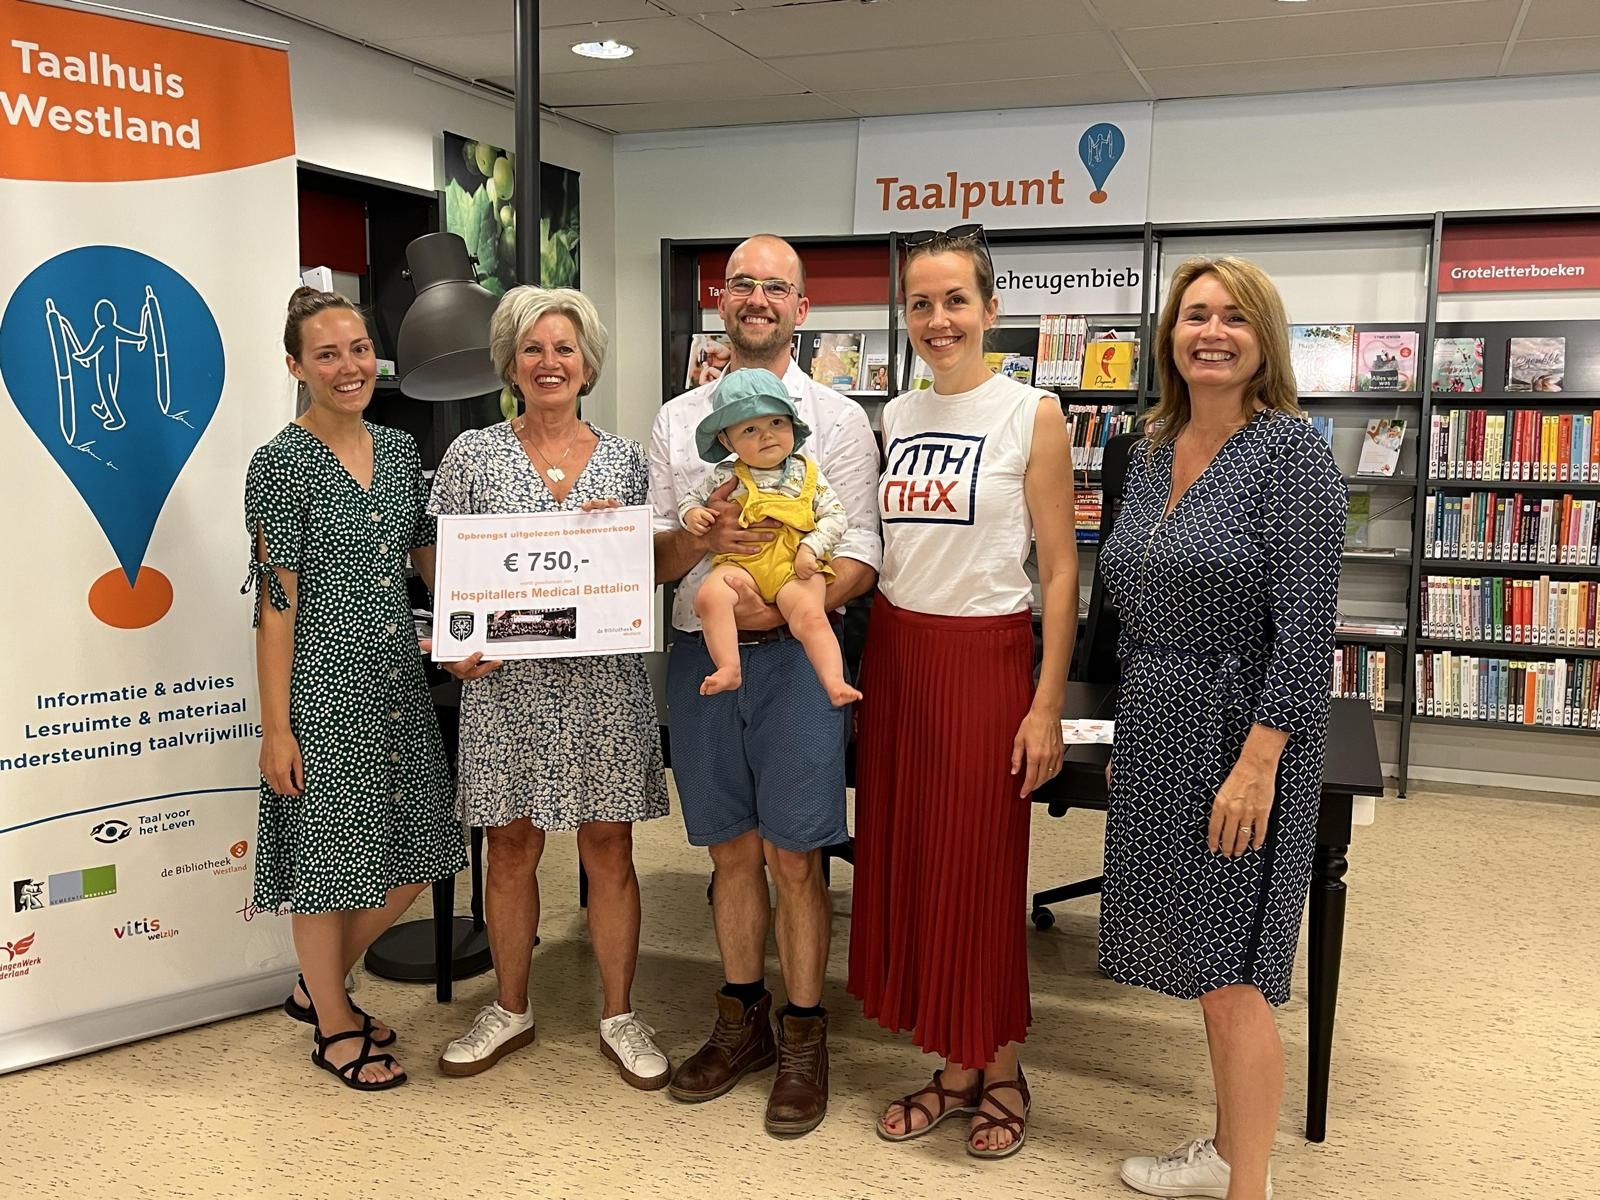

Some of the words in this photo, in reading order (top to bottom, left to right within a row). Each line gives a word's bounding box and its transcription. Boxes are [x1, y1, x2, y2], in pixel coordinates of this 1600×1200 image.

[11, 39, 185, 99] Taalhuis
[0, 91, 201, 150] Westland
[876, 170, 1065, 219] Taalpunt
[995, 268, 1139, 295] eheugenbieb
[1451, 264, 1585, 279] Groteletterboeken
[708, 286, 725, 297] Ta
[884, 480, 959, 512] ПНХ
[457, 531, 507, 541] Opbrengst
[511, 529, 560, 539] uitgelezen
[563, 524, 635, 537] boekenverkoop
[504, 553, 519, 572] €
[528, 551, 589, 573] 750,-
[451, 588, 528, 602] Hospitallers
[531, 587, 579, 598] Medical
[584, 583, 640, 595] Battalion
[37, 685, 148, 709] Informatie
[154, 682, 167, 696] &
[173, 676, 235, 693] advies
[25, 714, 131, 739] Lesruimte
[138, 711, 151, 725] &
[158, 698, 247, 723] materiaal
[0, 739, 142, 770] ndersteuning
[149, 722, 264, 751] taalvrijwillig
[138, 813, 162, 825] Taal
[165, 809, 191, 821] voor
[139, 824, 159, 835] het
[162, 818, 195, 834] Leven
[161, 868, 173, 878] de
[176, 857, 231, 875] Bibliotheek
[213, 864, 247, 876] Westland
[114, 918, 160, 939] vitis
[148, 929, 179, 941] welzijn
